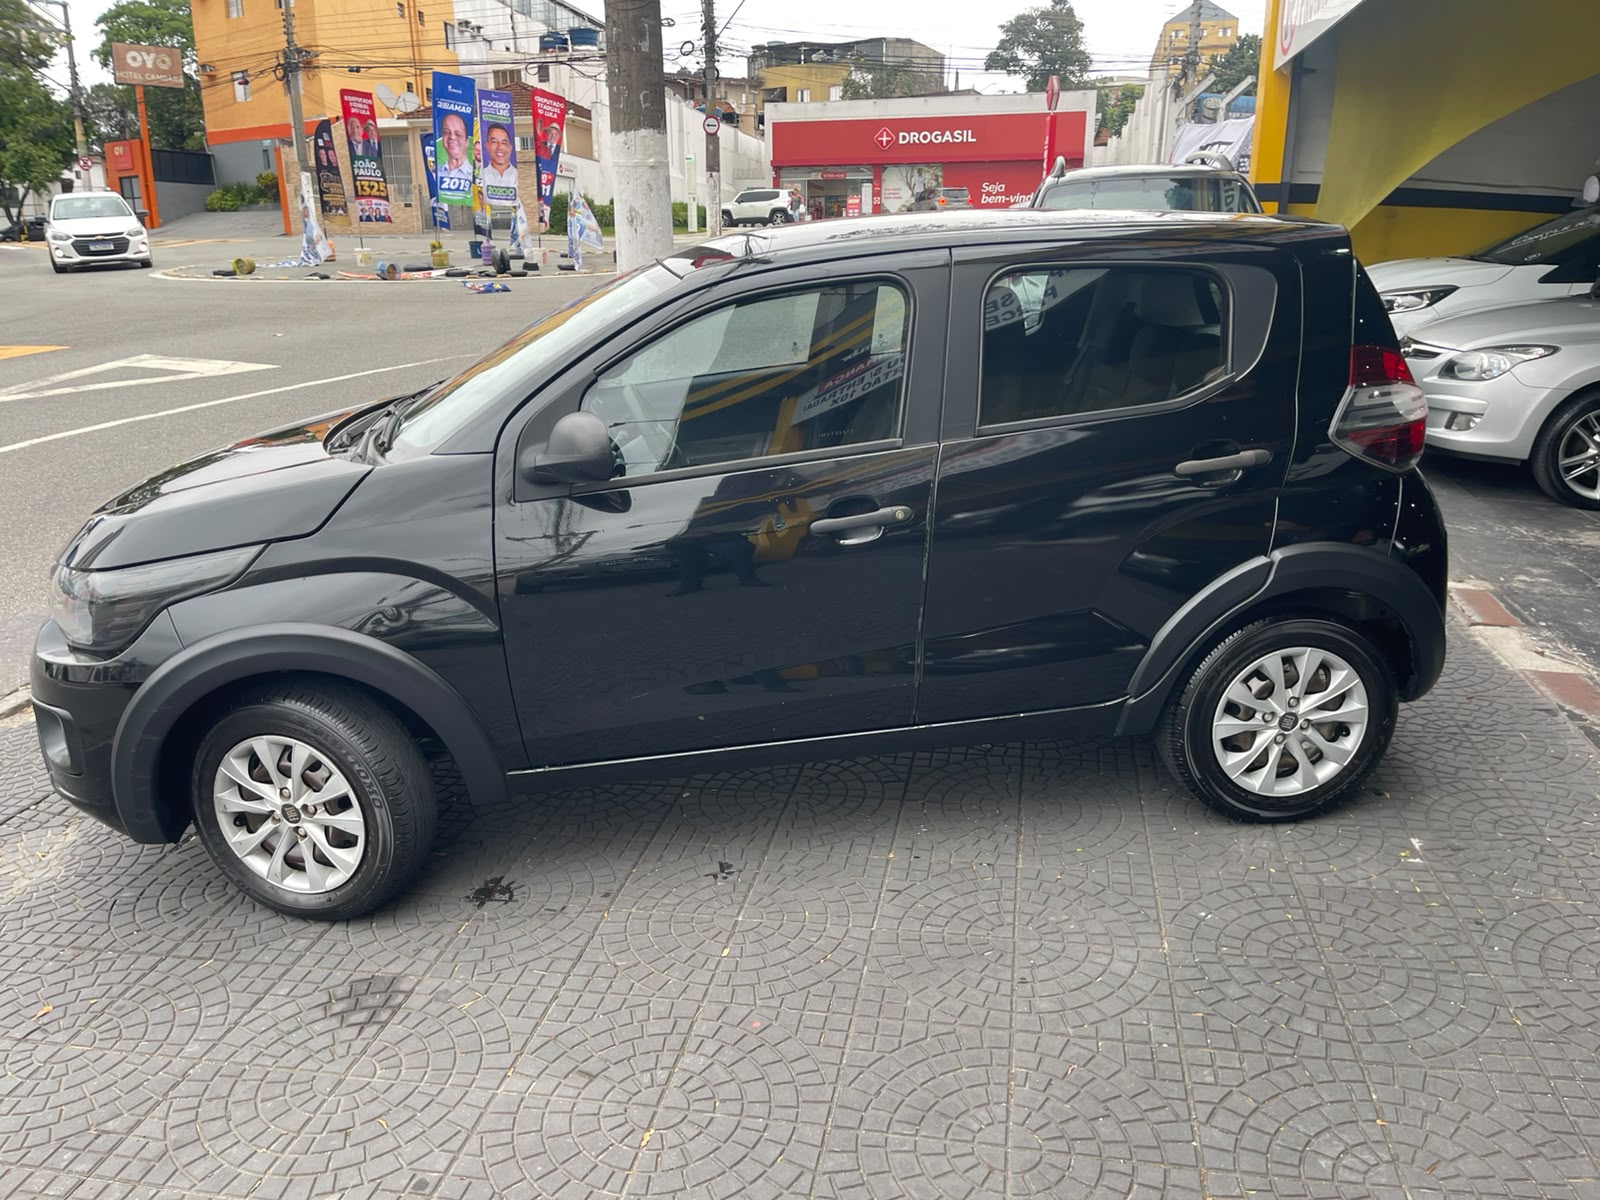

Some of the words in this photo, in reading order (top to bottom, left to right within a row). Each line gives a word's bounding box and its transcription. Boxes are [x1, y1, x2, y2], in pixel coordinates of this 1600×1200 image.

[126, 51, 172, 70] OYO
[898, 129, 977, 145] DROGASIL
[353, 159, 377, 169] JOÃO
[354, 168, 382, 177] PAULO
[355, 181, 387, 197] 1325
[441, 177, 471, 192] 2019
[981, 182, 1006, 195] Seja
[981, 192, 1034, 204] bem-vind
